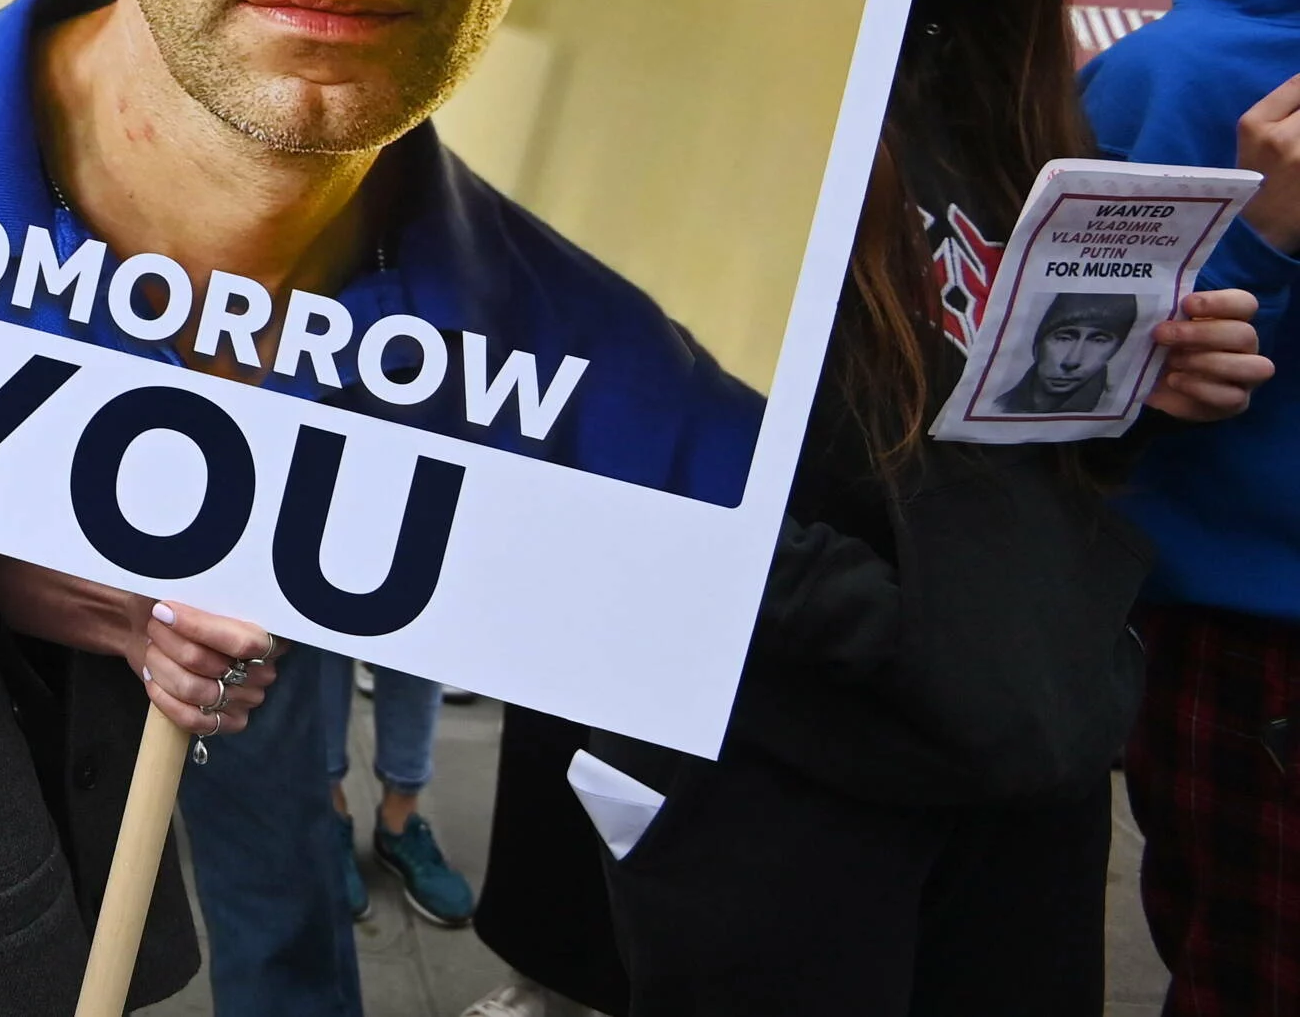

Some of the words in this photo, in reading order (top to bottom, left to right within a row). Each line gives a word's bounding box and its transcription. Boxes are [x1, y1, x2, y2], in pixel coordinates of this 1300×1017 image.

[1095, 204, 1176, 218] WANTED
[1086, 220, 1163, 233] VLADIMIR
[1051, 231, 1180, 247] VLADIMIROVICH
[1080, 246, 1128, 260] PUTIN
[1045, 261, 1080, 278] FOR
[1082, 262, 1153, 279] MURDER
